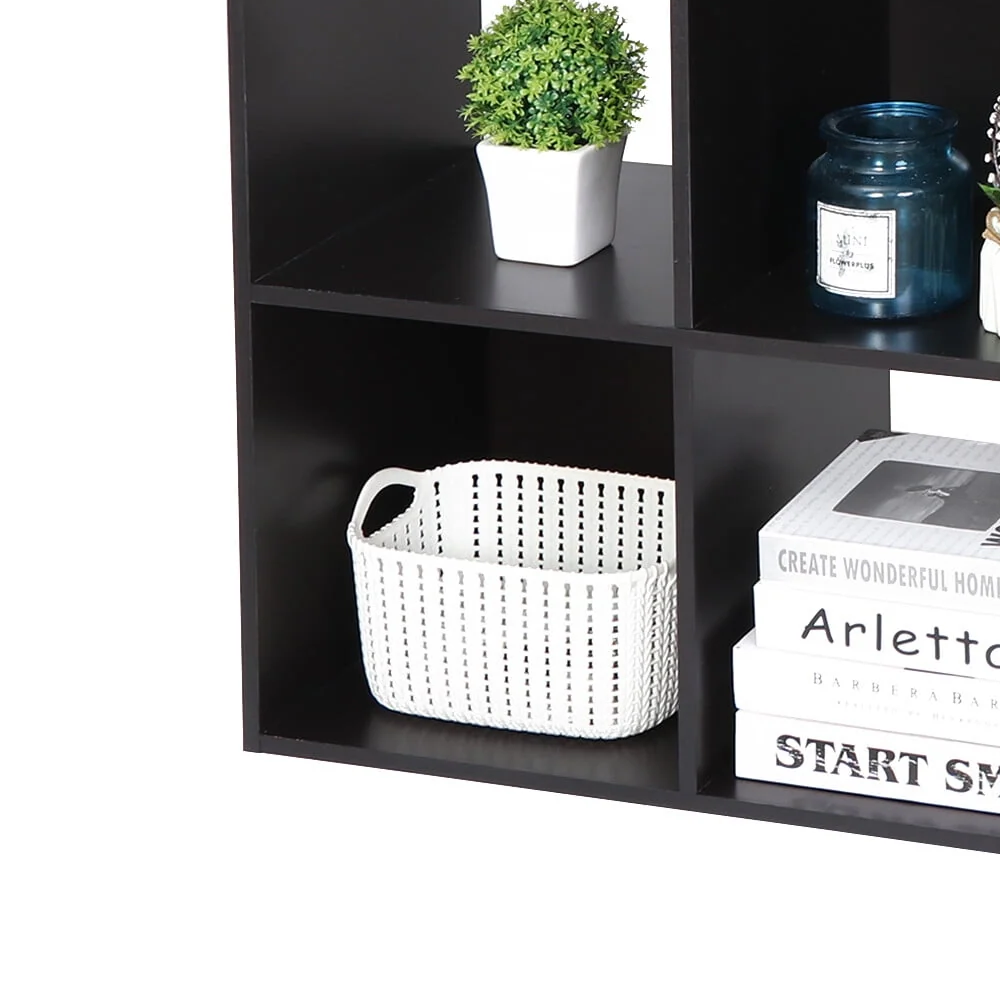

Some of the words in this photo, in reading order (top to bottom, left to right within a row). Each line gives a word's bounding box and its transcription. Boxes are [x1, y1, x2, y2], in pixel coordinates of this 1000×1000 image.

[778, 549, 837, 578] CREATE
[843, 556, 948, 592] WONDERFUL
[813, 672, 938, 702] BARBERA
[775, 734, 929, 786] START
